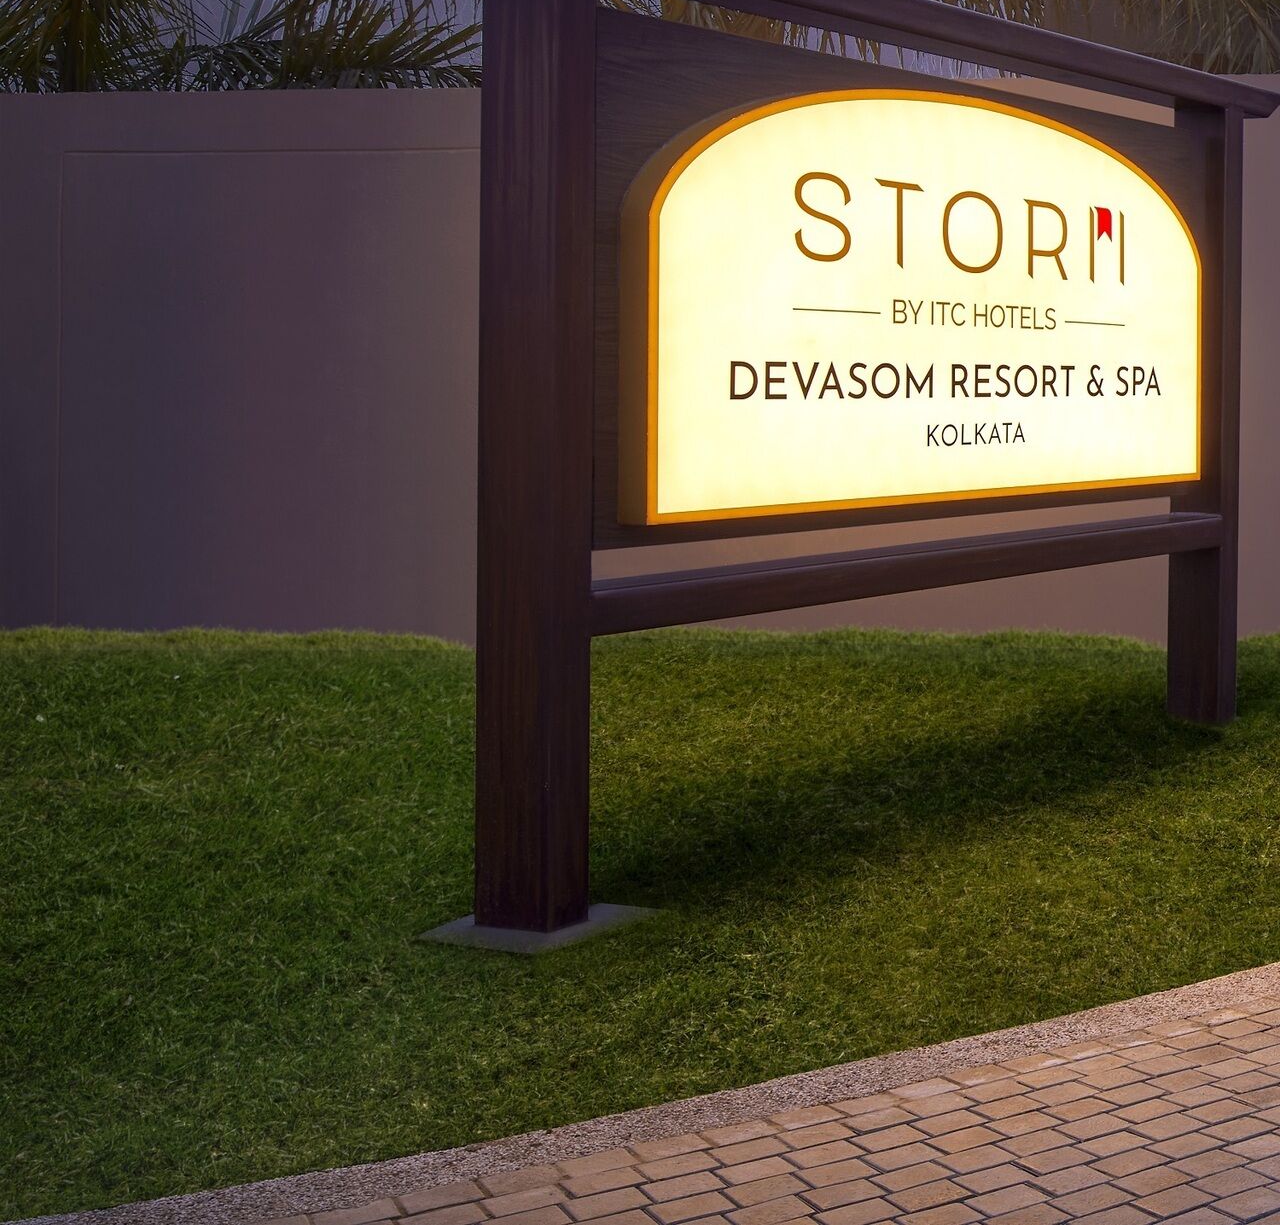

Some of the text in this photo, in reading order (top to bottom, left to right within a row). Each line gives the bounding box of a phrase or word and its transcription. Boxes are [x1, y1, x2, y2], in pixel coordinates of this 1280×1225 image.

[892, 299, 1057, 330] BY ITC HOTELS
[729, 361, 1162, 401] DEVASOM RESORT & SPA
[926, 422, 1026, 447] KOLKATA
